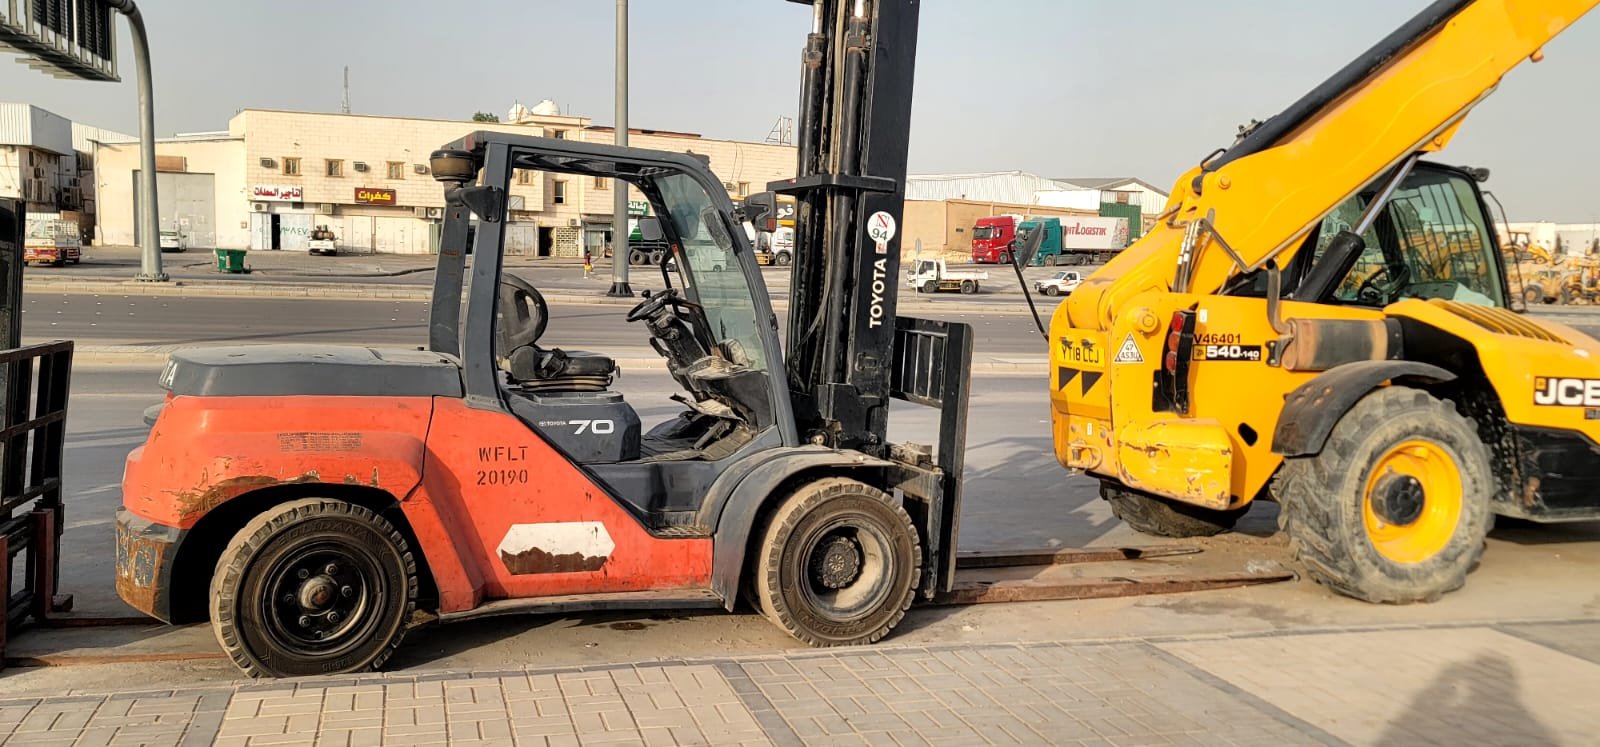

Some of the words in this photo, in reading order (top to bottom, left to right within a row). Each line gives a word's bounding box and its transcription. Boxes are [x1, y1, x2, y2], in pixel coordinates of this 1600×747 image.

[358, 190, 391, 202] كفرات
[872, 227, 888, 241] 94
[869, 258, 887, 329] TOYOTA
[1193, 333, 1241, 344] V46401
[568, 419, 614, 435] 70
[478, 446, 528, 462] WFLT
[476, 469, 528, 486] 20190
